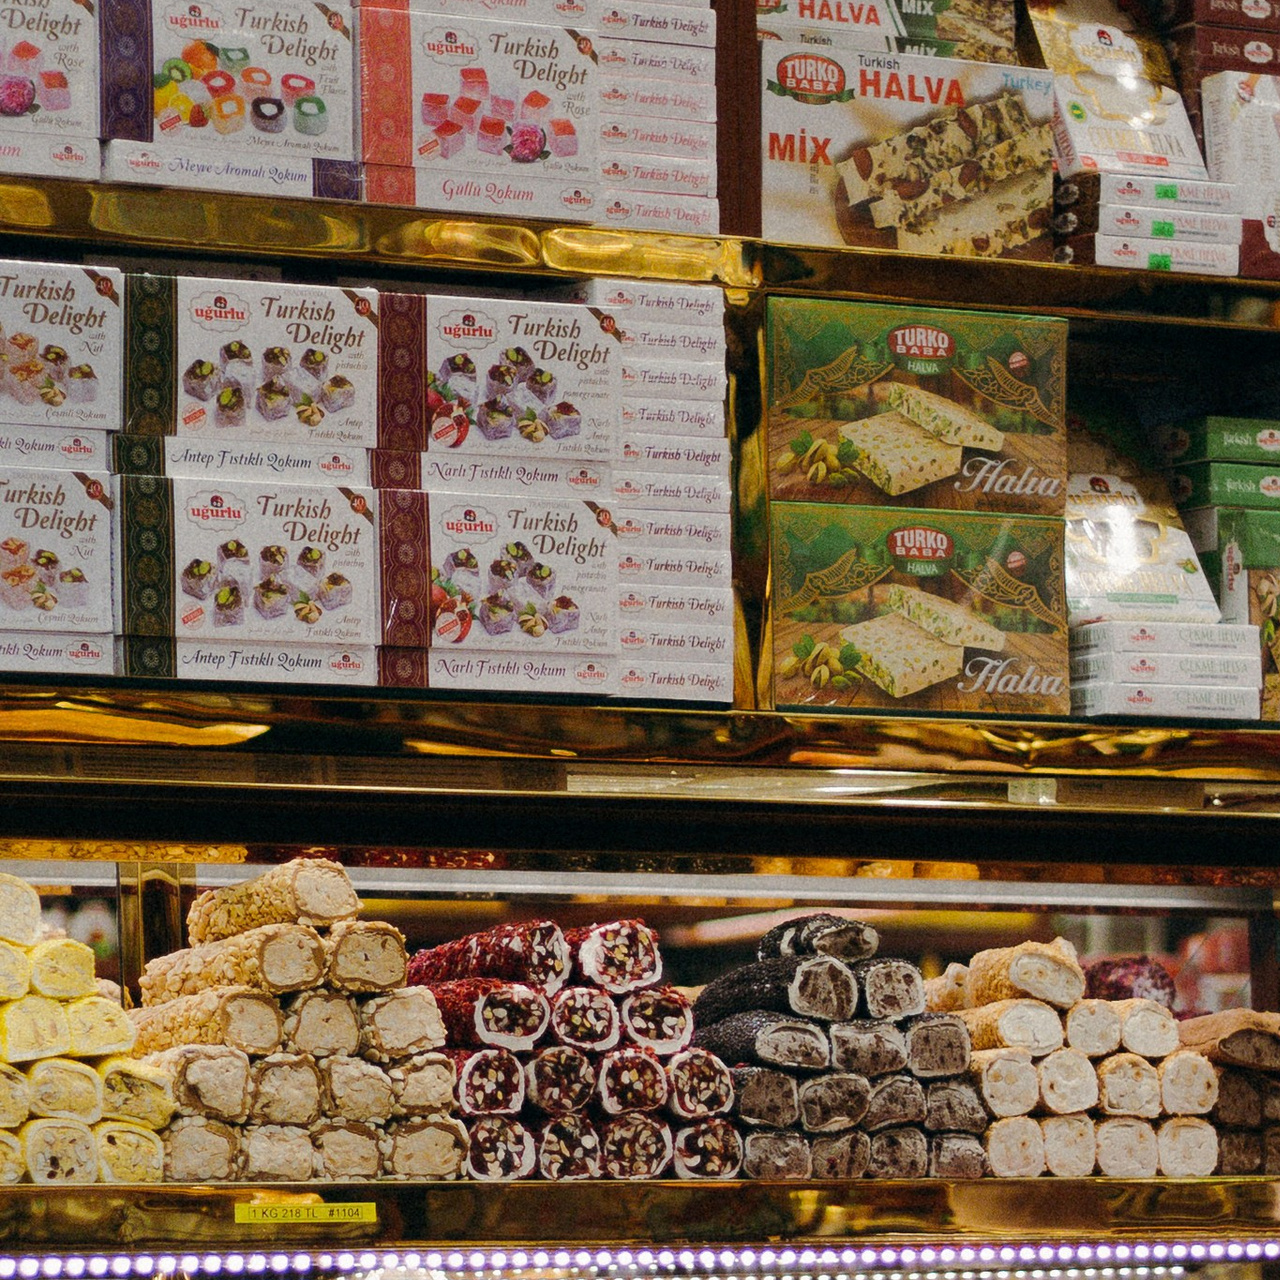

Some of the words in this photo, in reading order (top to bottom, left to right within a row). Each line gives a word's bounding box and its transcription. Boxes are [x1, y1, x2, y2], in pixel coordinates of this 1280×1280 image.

[0, 8, 81, 41] Delight
[169, 14, 221, 30] uğurlu
[234, 7, 308, 34] Turkish
[632, 14, 668, 30] Turkish
[671, 18, 708, 35] Delight
[261, 34, 339, 65] Delight
[427, 41, 475, 56] uğurlu
[489, 33, 560, 60] Turkish
[800, 34, 833, 46] Turkish
[53, 52, 85, 71] Rose
[786, 58, 839, 83] TURKO
[858, 55, 900, 70] Turkish
[513, 59, 588, 91] Delight
[1003, 72, 1051, 96] Turkey
[787, 78, 837, 93] BABA
[859, 70, 966, 108] HALVA
[566, 91, 586, 103] with
[562, 101, 591, 117] Rose
[768, 128, 833, 166] MİX
[168, 157, 212, 176] Meyve
[0, 276, 75, 303] Turkish
[194, 306, 246, 323] uğurlu
[260, 296, 336, 323] Turkish
[638, 295, 674, 309] Turkish
[677, 297, 715, 315] Delight
[23, 302, 107, 335] Delight
[508, 314, 581, 339] Turkish
[286, 323, 366, 354] Delight
[443, 324, 493, 339] uğurlu
[895, 328, 949, 348] TURKO
[79, 340, 105, 356] Nut
[533, 340, 611, 370] Delight
[896, 346, 947, 357] BABA
[907, 361, 939, 373] HALVA
[61, 443, 93, 457] uğurlu
[171, 450, 215, 470] Antep
[644, 446, 681, 461] Turkish
[683, 449, 721, 466] Delight
[427, 462, 467, 482] Narlı
[954, 457, 1066, 498] Halva
[190, 506, 242, 522] uğurlu
[257, 494, 331, 521] Turkish
[14, 507, 98, 539] Delight
[446, 520, 493, 534] uğurlu
[507, 509, 578, 533] Turkish
[283, 521, 362, 552] Delight
[894, 529, 948, 550] TURKO
[70, 544, 94, 558] Nut
[532, 534, 607, 563] Delight
[896, 547, 946, 558] BABA
[907, 563, 938, 574] HALVA
[182, 650, 225, 670] Antep
[434, 659, 473, 678] Narlı
[957, 657, 1066, 696] Halva
[262, 1208, 278, 1218] KG
[282, 1208, 301, 1218] 218
[306, 1208, 318, 1218] TL
[328, 1208, 360, 1218] #1104
